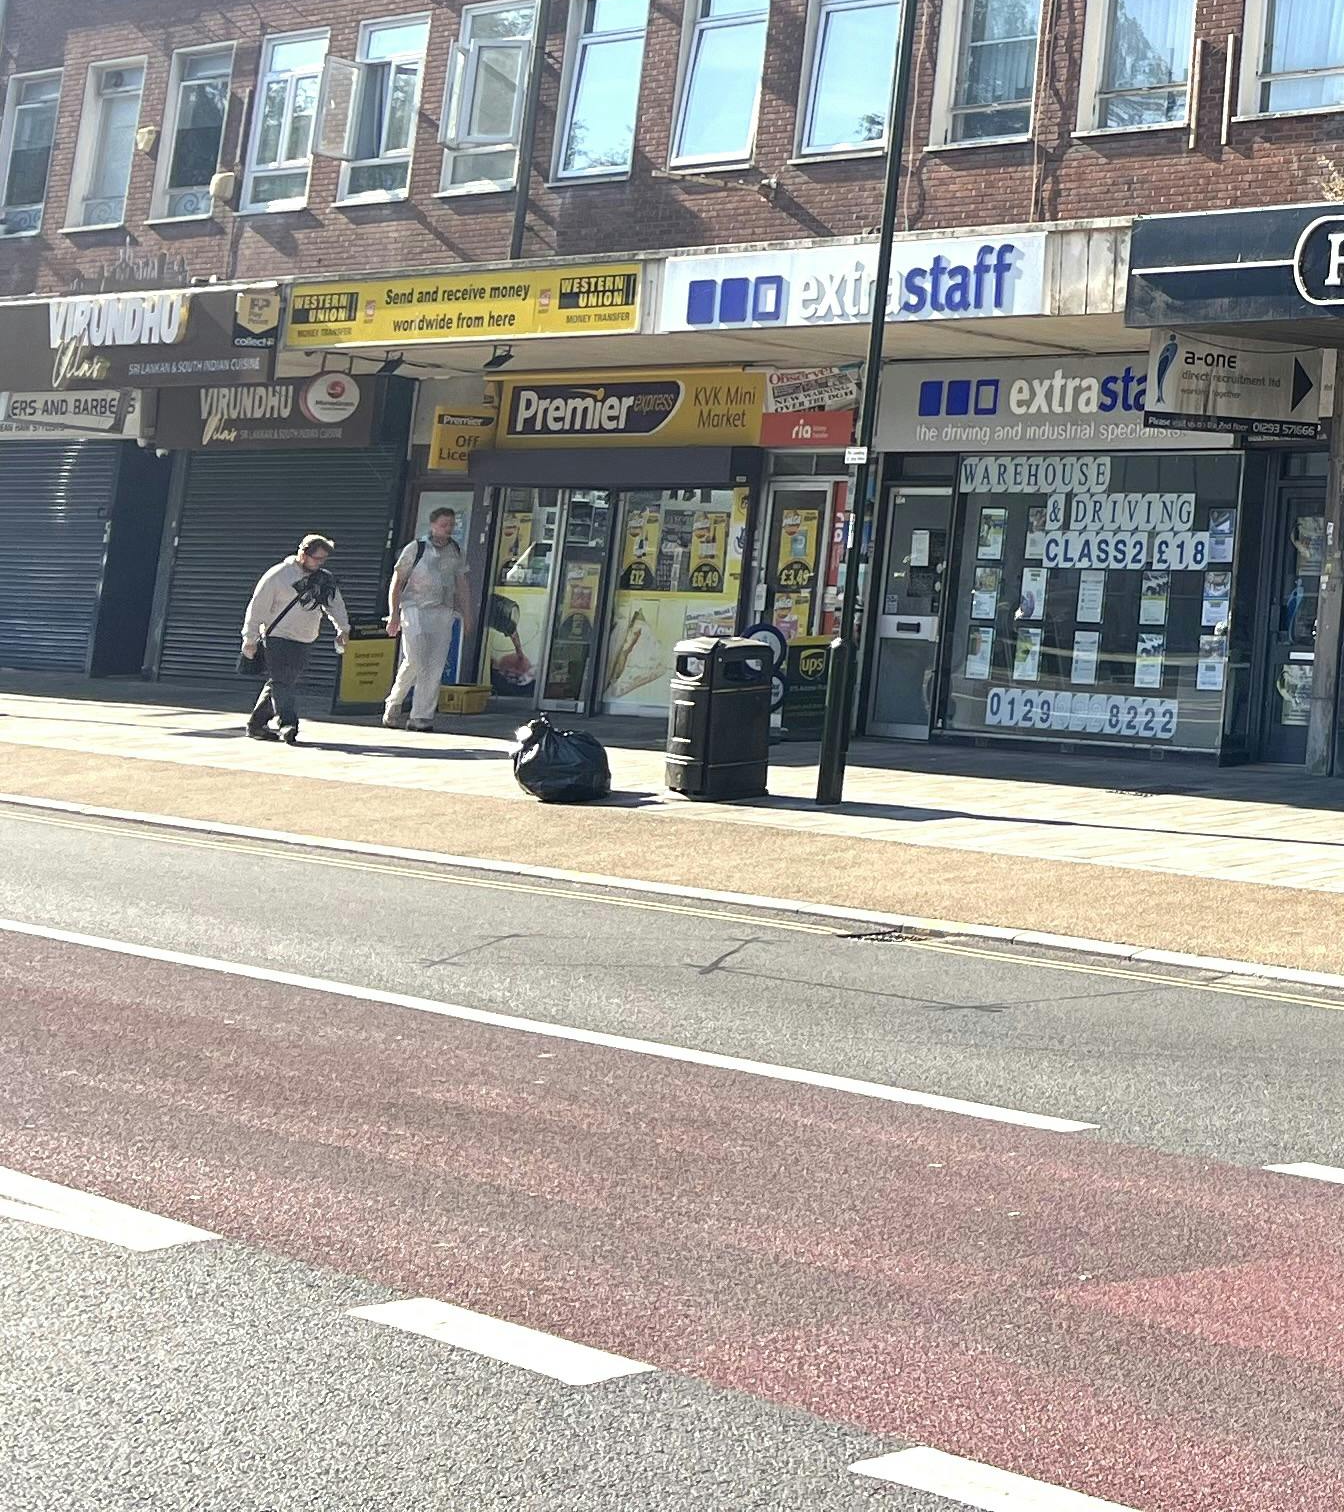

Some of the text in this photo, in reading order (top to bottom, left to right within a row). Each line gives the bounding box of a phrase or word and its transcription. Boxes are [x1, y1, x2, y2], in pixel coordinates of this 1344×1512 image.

[560, 275, 624, 294] WESTERN
[293, 293, 347, 310] WESTERN
[385, 284, 530, 306] Send and receive money
[578, 290, 624, 308] UNION
[49, 294, 184, 349] VIRUNDHU
[308, 308, 347, 323] UNION
[457, 313, 484, 329] from
[488, 311, 515, 327] here
[566, 312, 630, 324] MONEY TRANSFER
[1184, 350, 1238, 369] a-one
[769, 367, 835, 386] Observer
[1181, 371, 1210, 383] direct
[1213, 373, 1266, 387] recruitment
[200, 385, 294, 420] VIRUNDHU
[693, 386, 756, 406] KVK Mini
[41, 398, 68, 416] AND
[73, 397, 137, 416] BARBES
[515, 389, 674, 433] Premier express
[443, 415, 485, 426] Premier
[697, 410, 746, 430] Market
[791, 418, 812, 439] ria
[1252, 422, 1279, 434] 01293
[455, 435, 480, 449] Off
[916, 424, 938, 441] the
[942, 423, 991, 445] driving
[994, 422, 1022, 440] and
[1026, 420, 1094, 440] industrial
[439, 448, 468, 461] Lice
[963, 463, 1108, 487] WAREHOUSE
[1049, 499, 1194, 525] & DRIVING
[1156, 540, 1206, 566] £18
[629, 570, 645, 585] £12
[801, 657, 824, 675] ups
